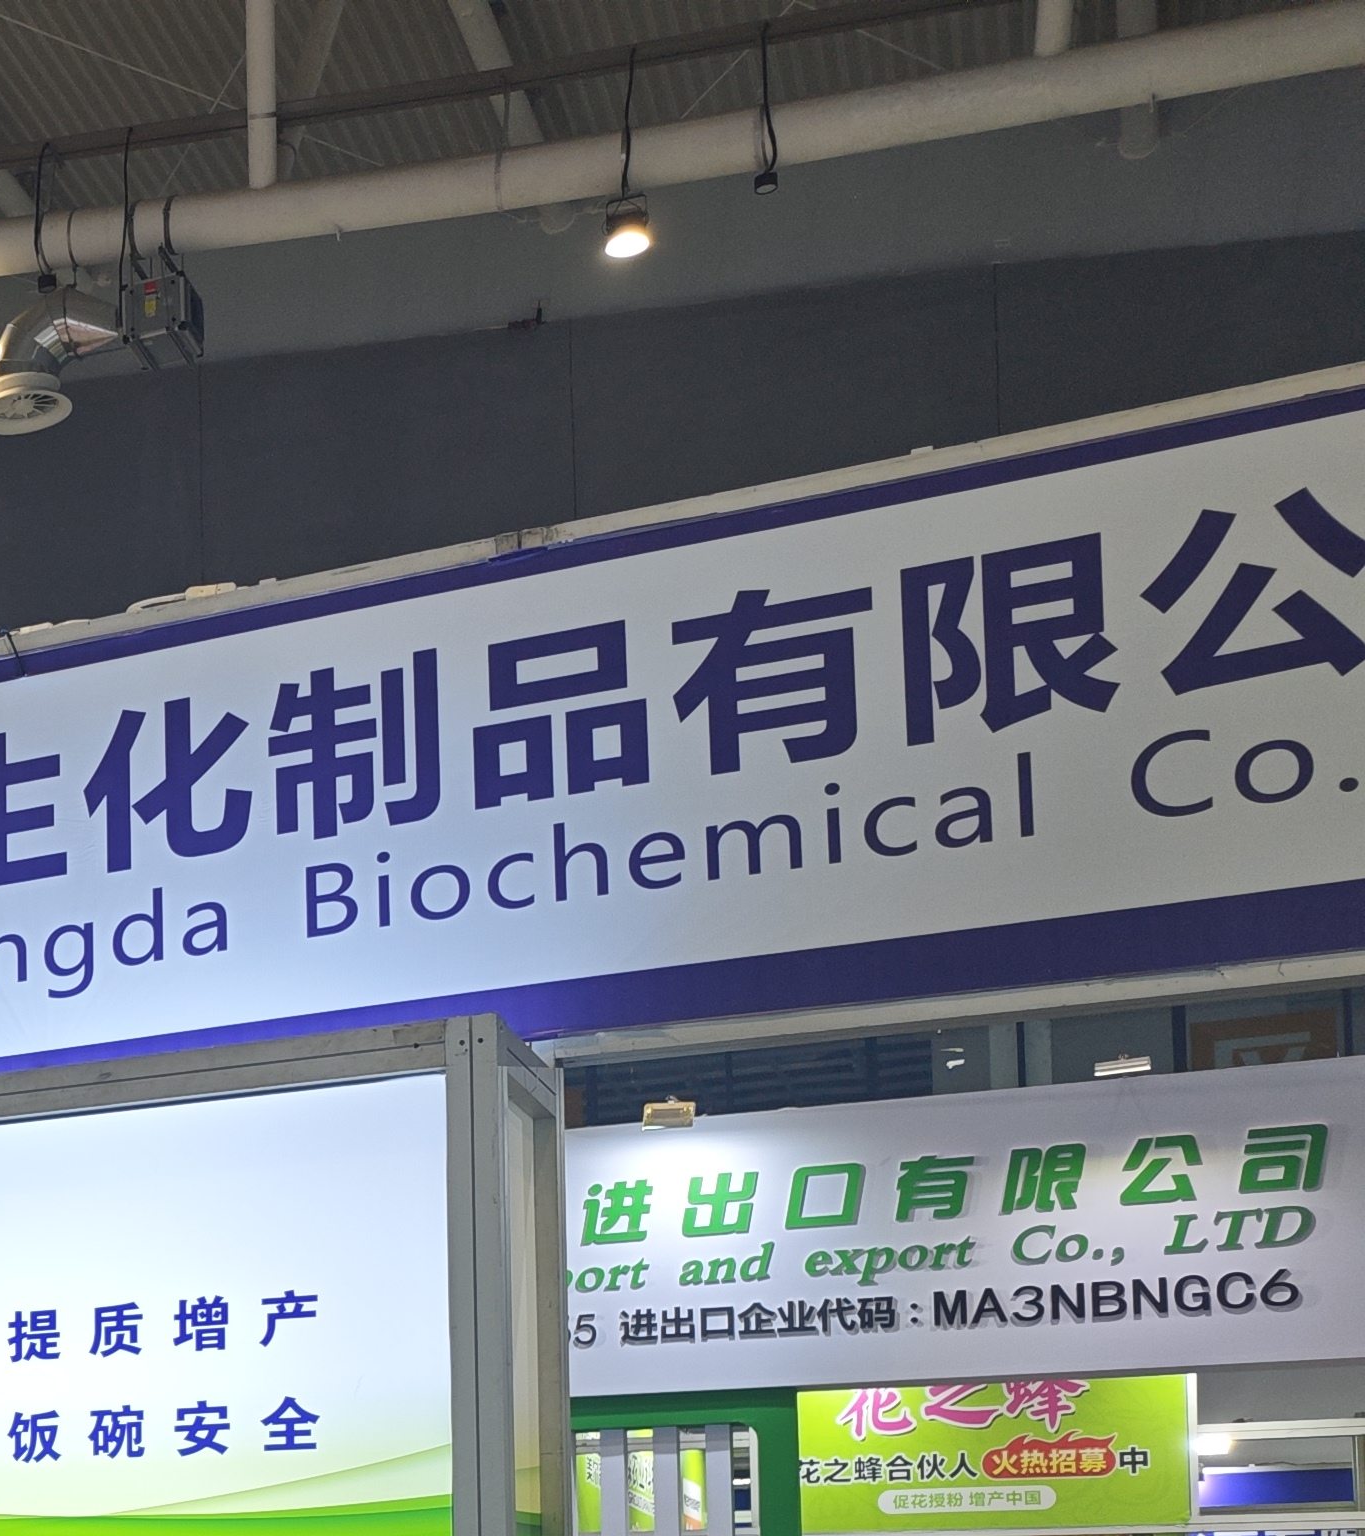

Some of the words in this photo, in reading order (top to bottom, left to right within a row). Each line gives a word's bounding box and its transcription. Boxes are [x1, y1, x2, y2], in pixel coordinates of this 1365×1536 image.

[305, 751, 1036, 939] Biochemical
[582, 1122, 1329, 1246] 进出口有限公司
[566, 1257, 650, 1295] ort
[678, 1241, 775, 1287] and
[804, 1233, 977, 1286] export
[1012, 1224, 1125, 1268] Co.,
[1165, 1205, 1316, 1256] LTD
[568, 1313, 597, 1349] 5
[892, 1492, 963, 1510] 促花授粉
[969, 1490, 1042, 1507] 增产中国
